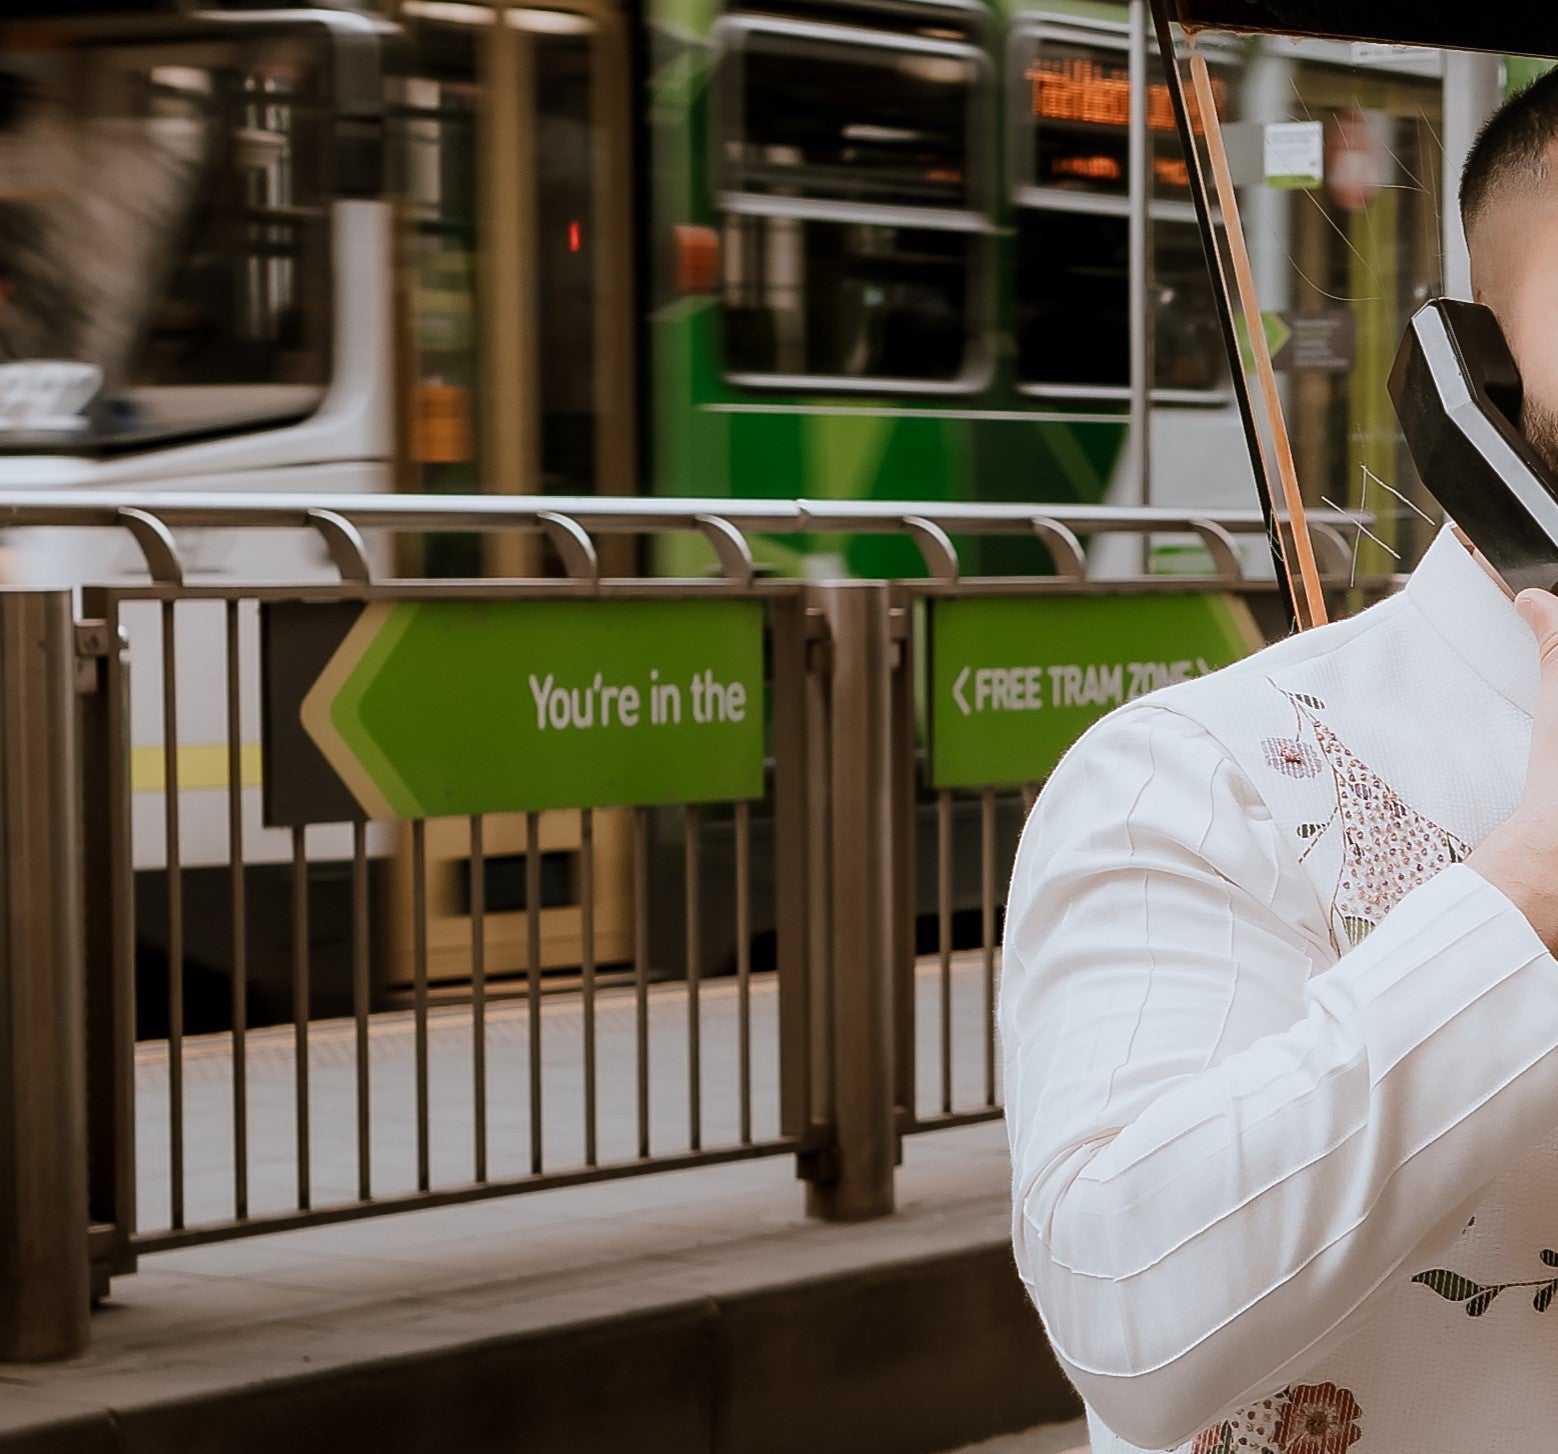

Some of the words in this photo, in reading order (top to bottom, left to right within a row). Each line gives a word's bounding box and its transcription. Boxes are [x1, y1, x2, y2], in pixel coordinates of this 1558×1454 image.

[530, 672, 639, 732] You're
[651, 668, 682, 725] in
[690, 667, 747, 724] the
[975, 667, 1043, 711] FREE
[1048, 664, 1123, 707] TRAM
